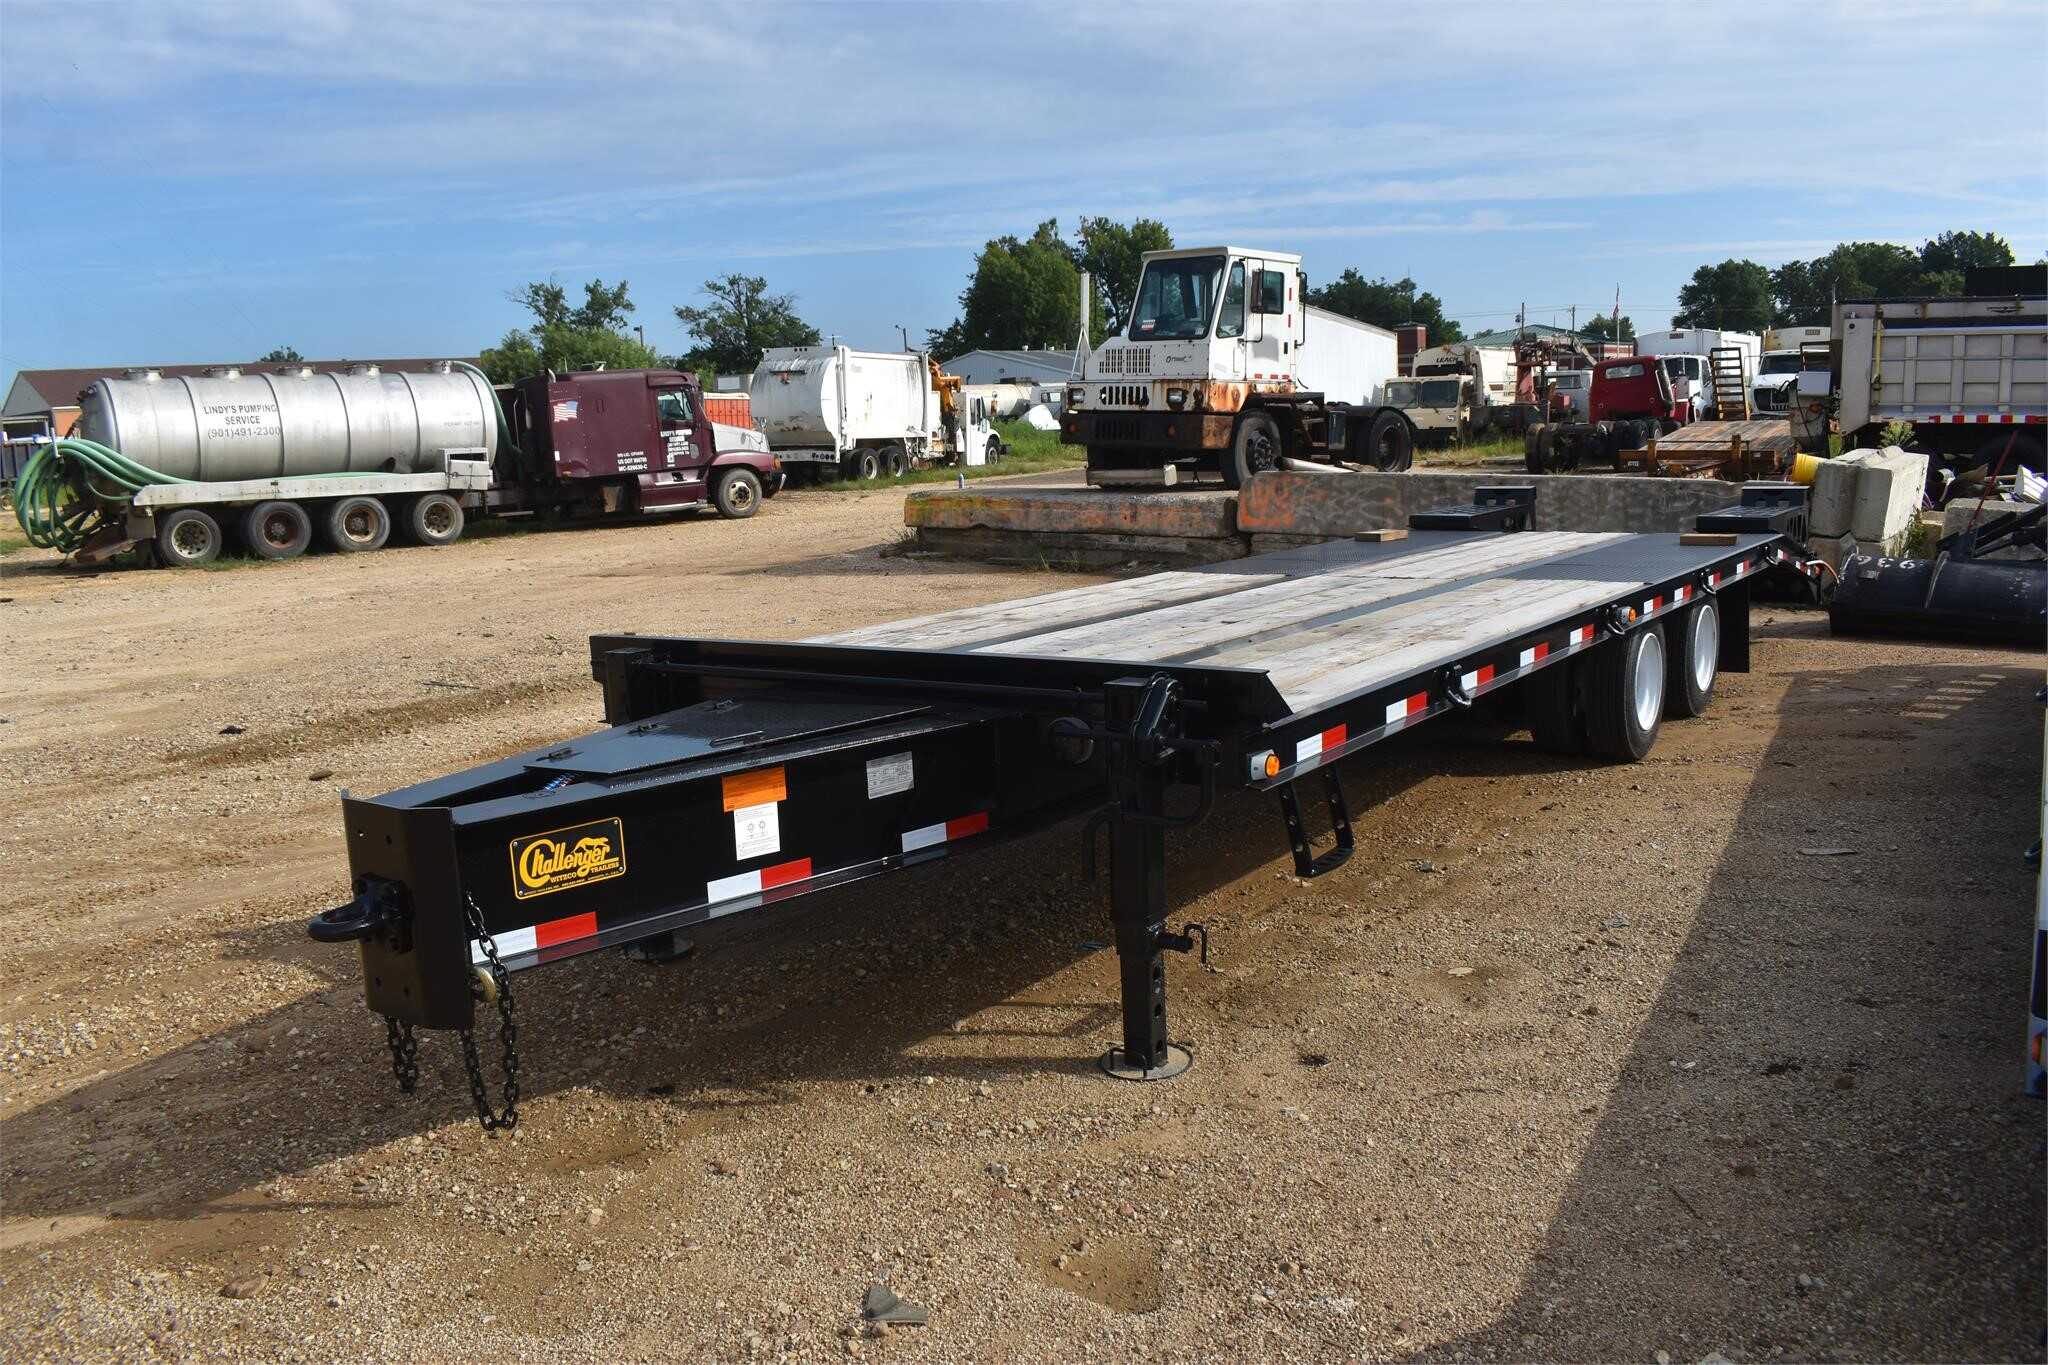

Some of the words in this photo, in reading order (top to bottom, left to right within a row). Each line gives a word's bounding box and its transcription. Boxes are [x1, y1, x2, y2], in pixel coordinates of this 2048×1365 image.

[203, 405, 237, 415] LINDY'S
[239, 404, 279, 414] PUMPING
[224, 416, 261, 425] SERVICE
[207, 426, 281, 440] (901)491-2300
[520, 838, 611, 888] Challenger
[550, 871, 577, 883] WITZCO
[590, 861, 620, 874] TRAILERS
